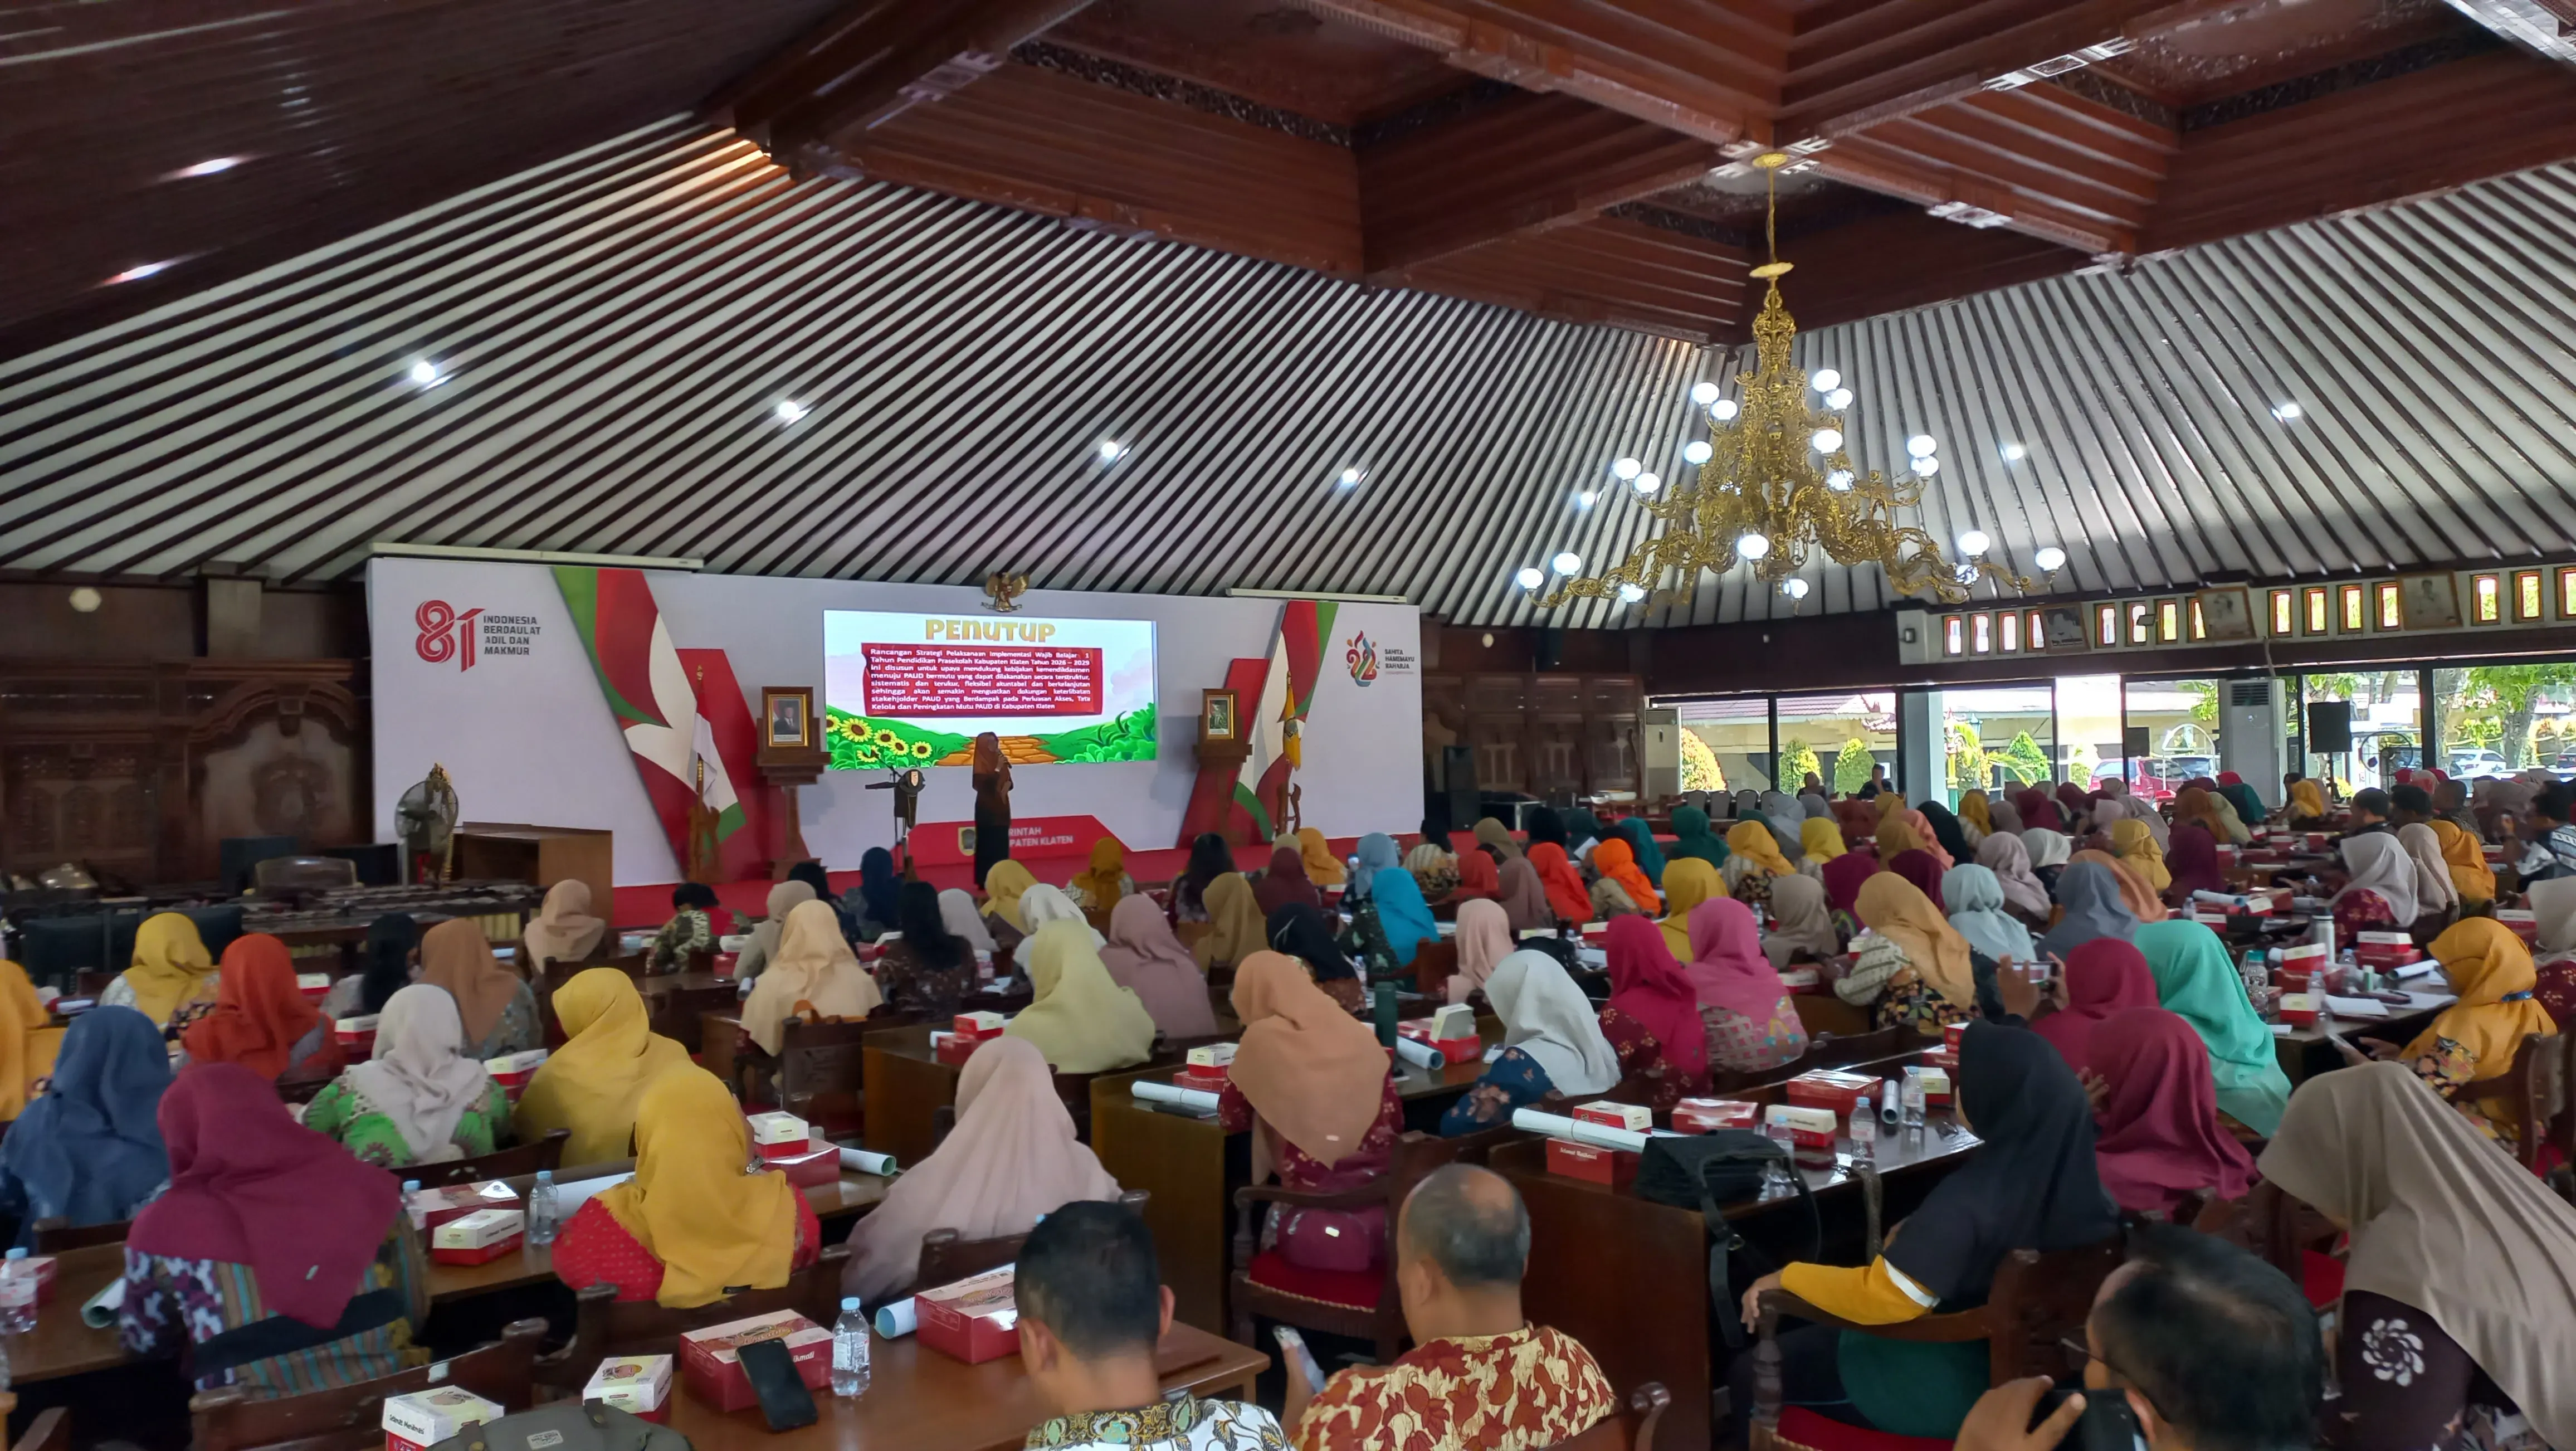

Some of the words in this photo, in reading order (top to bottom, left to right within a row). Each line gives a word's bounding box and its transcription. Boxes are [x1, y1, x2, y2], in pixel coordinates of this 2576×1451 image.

[484, 615, 538, 625] INDONESIA
[484, 625, 541, 635] BERDAULAT
[416, 600, 486, 673] 81
[485, 636, 506, 644] ADIL
[509, 636, 530, 645] DAN
[484, 646, 530, 655] MAKMUR
[1008, 827, 1042, 836] RINTAH
[1009, 837, 1038, 847] PATEN
[1040, 835, 1074, 845] KLATEN
[793, 1351, 815, 1363] ikmati
